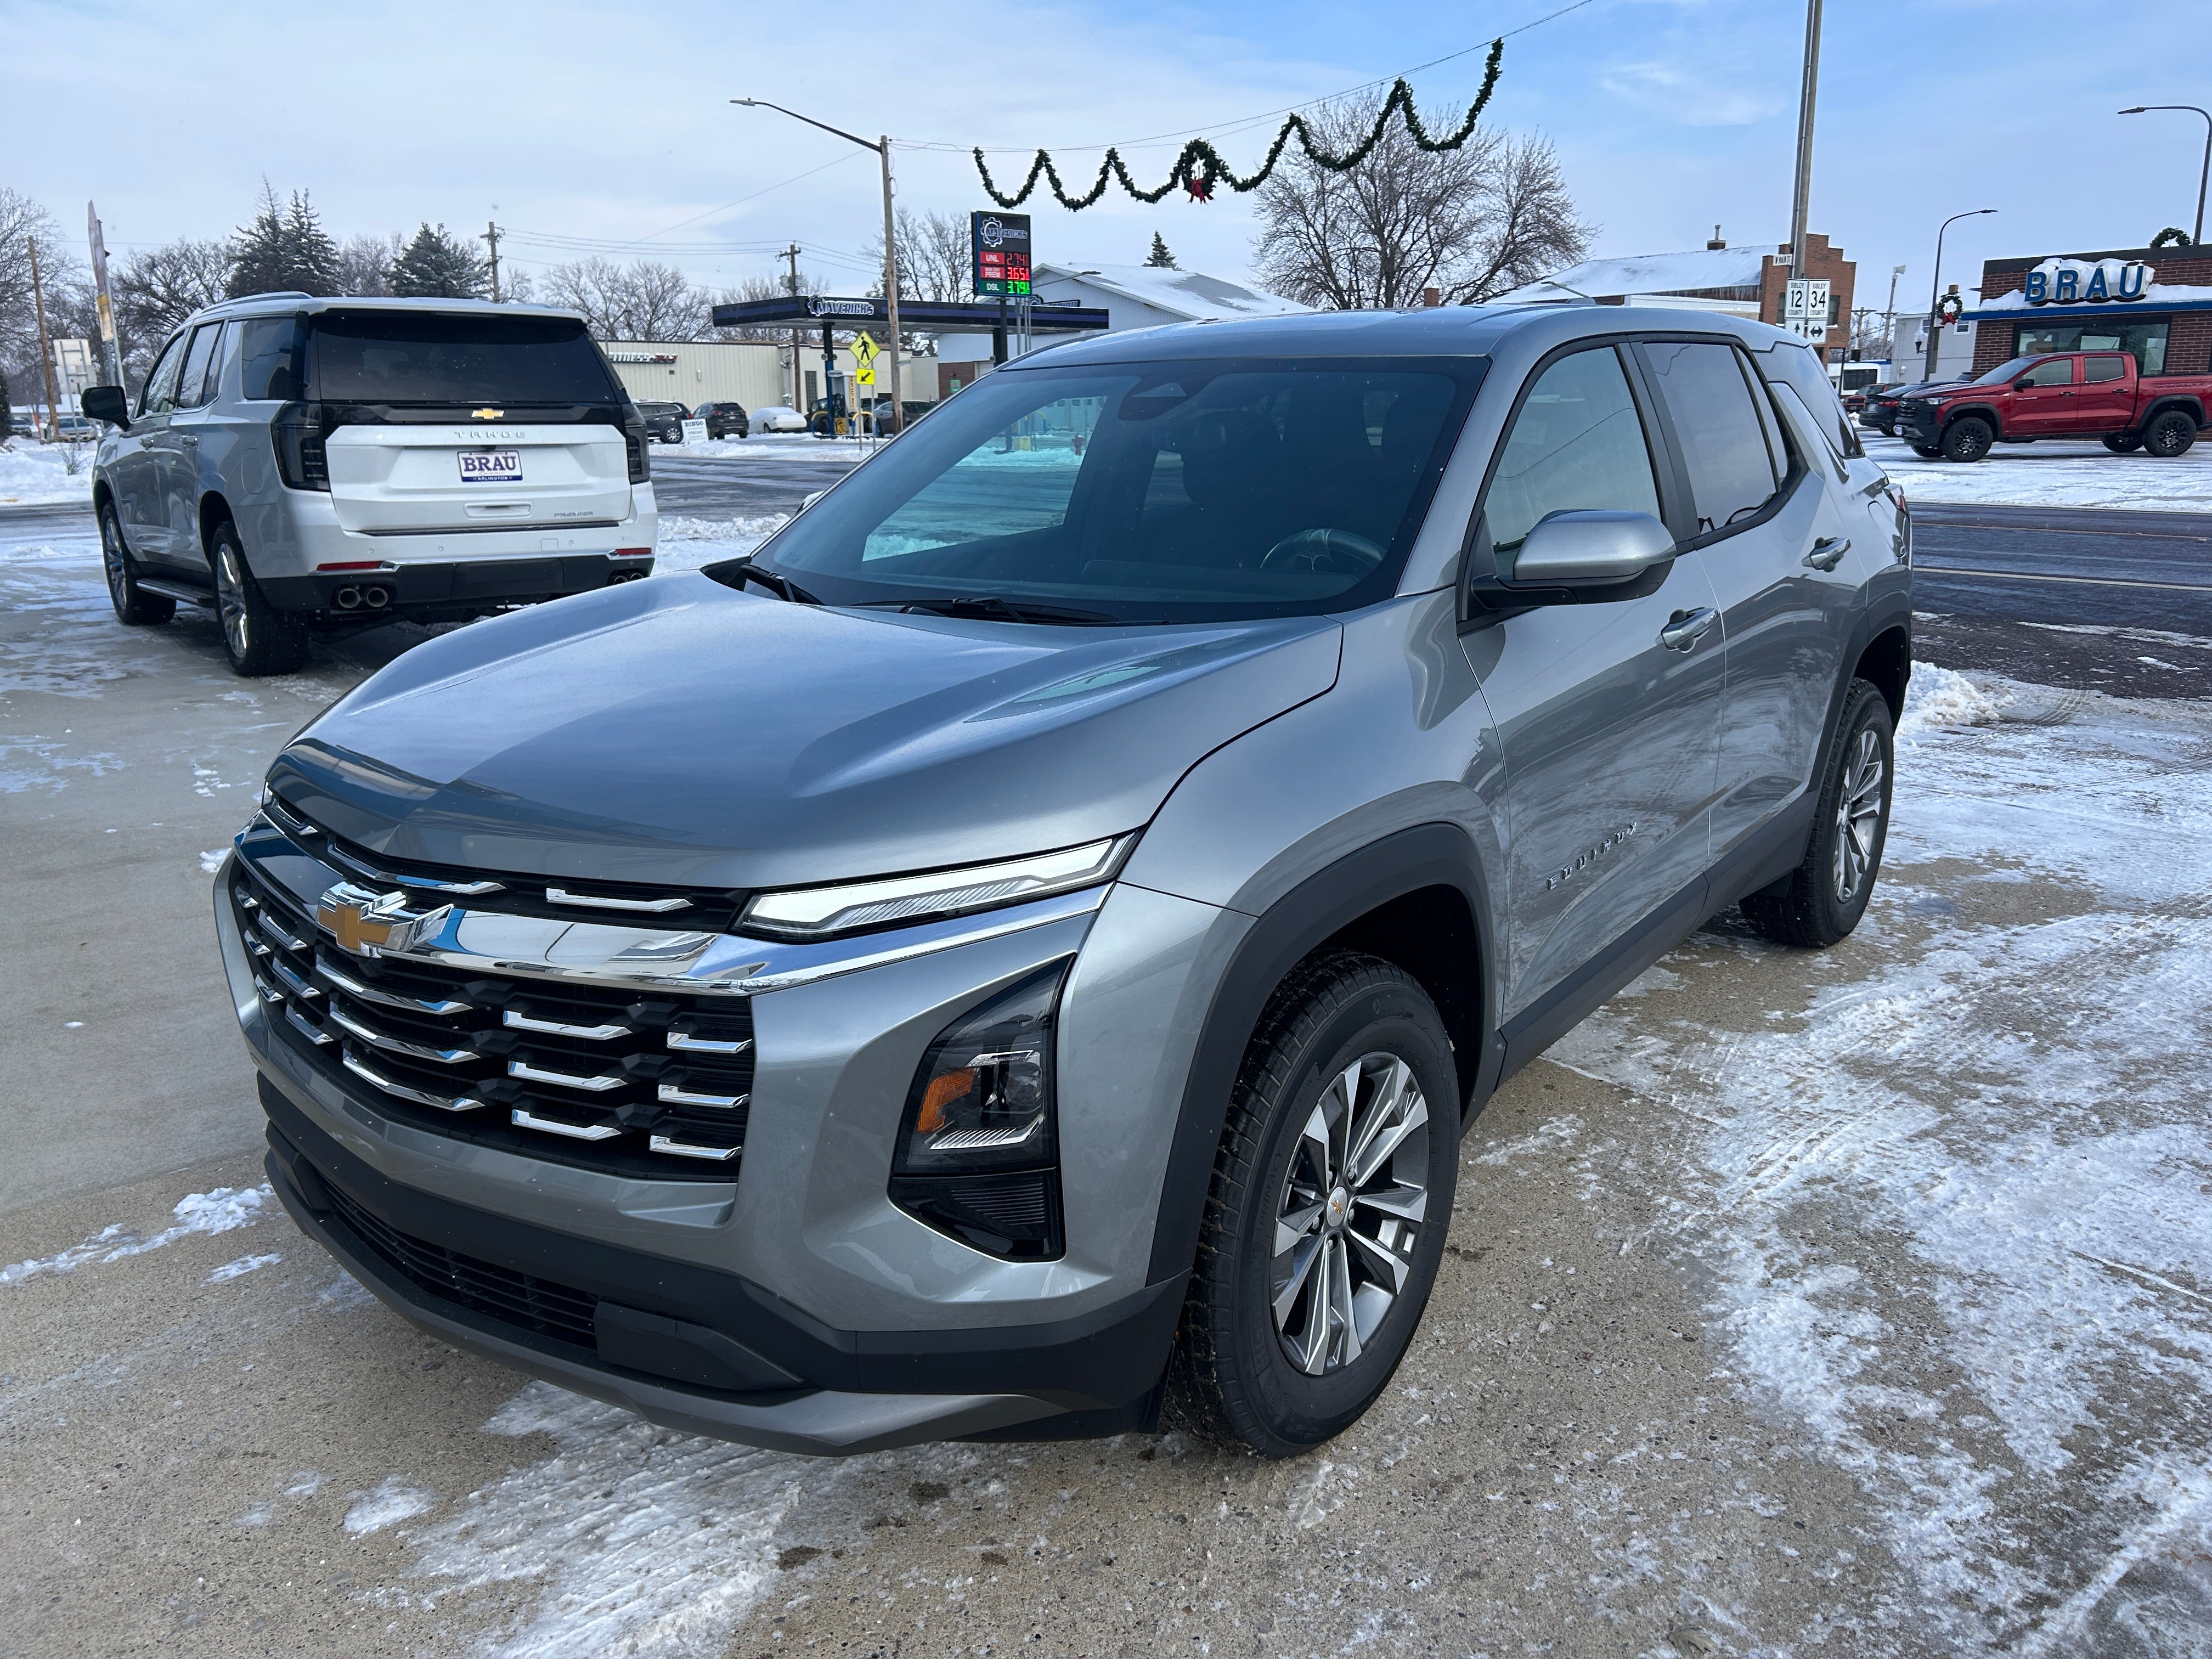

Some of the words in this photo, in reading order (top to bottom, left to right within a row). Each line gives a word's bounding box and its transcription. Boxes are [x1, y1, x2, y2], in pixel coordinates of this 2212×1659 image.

[986, 254, 999, 262] UNL
[2025, 266, 2145, 302] BRAU
[1791, 290, 1802, 308] 12
[1810, 290, 1826, 308] 34
[462, 456, 516, 472] BRAU
[1546, 820, 1637, 890] EQUINOX
